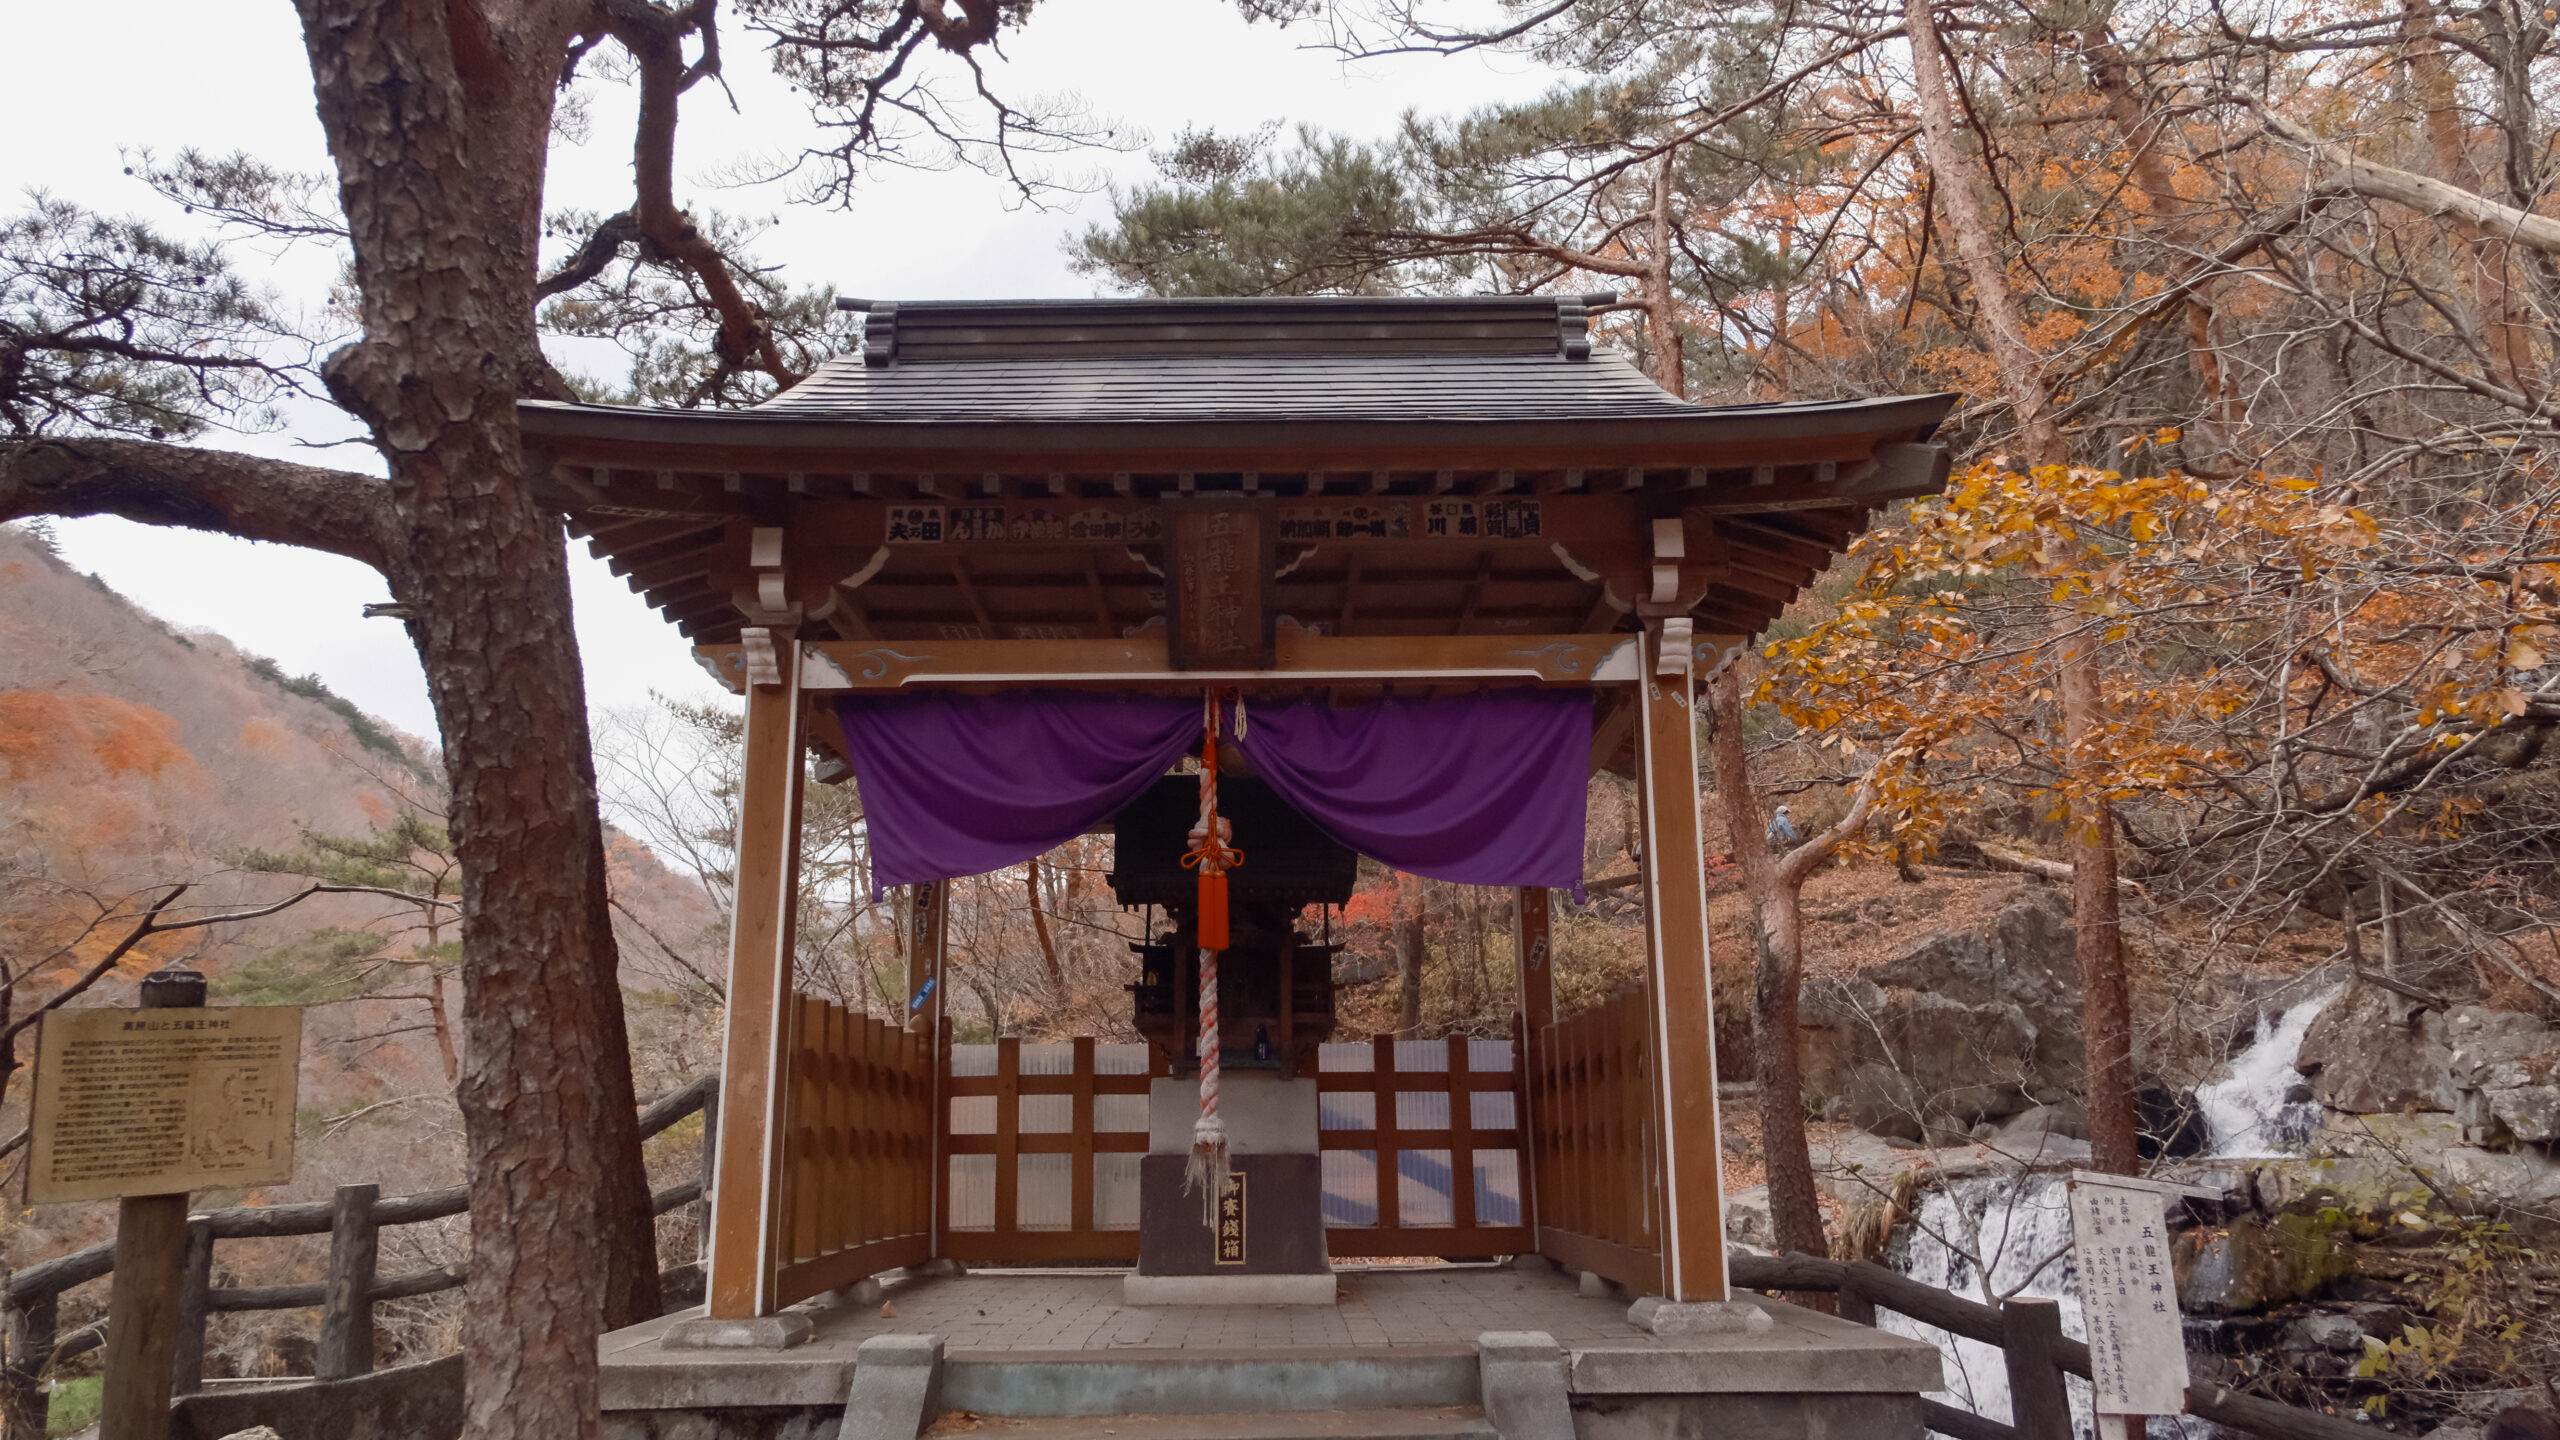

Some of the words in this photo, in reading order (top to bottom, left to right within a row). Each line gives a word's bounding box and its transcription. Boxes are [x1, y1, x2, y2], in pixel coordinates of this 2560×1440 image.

[2111, 1246, 2127, 1296] 四月十五日
[2141, 1226, 2168, 1313] 五龍王神社
